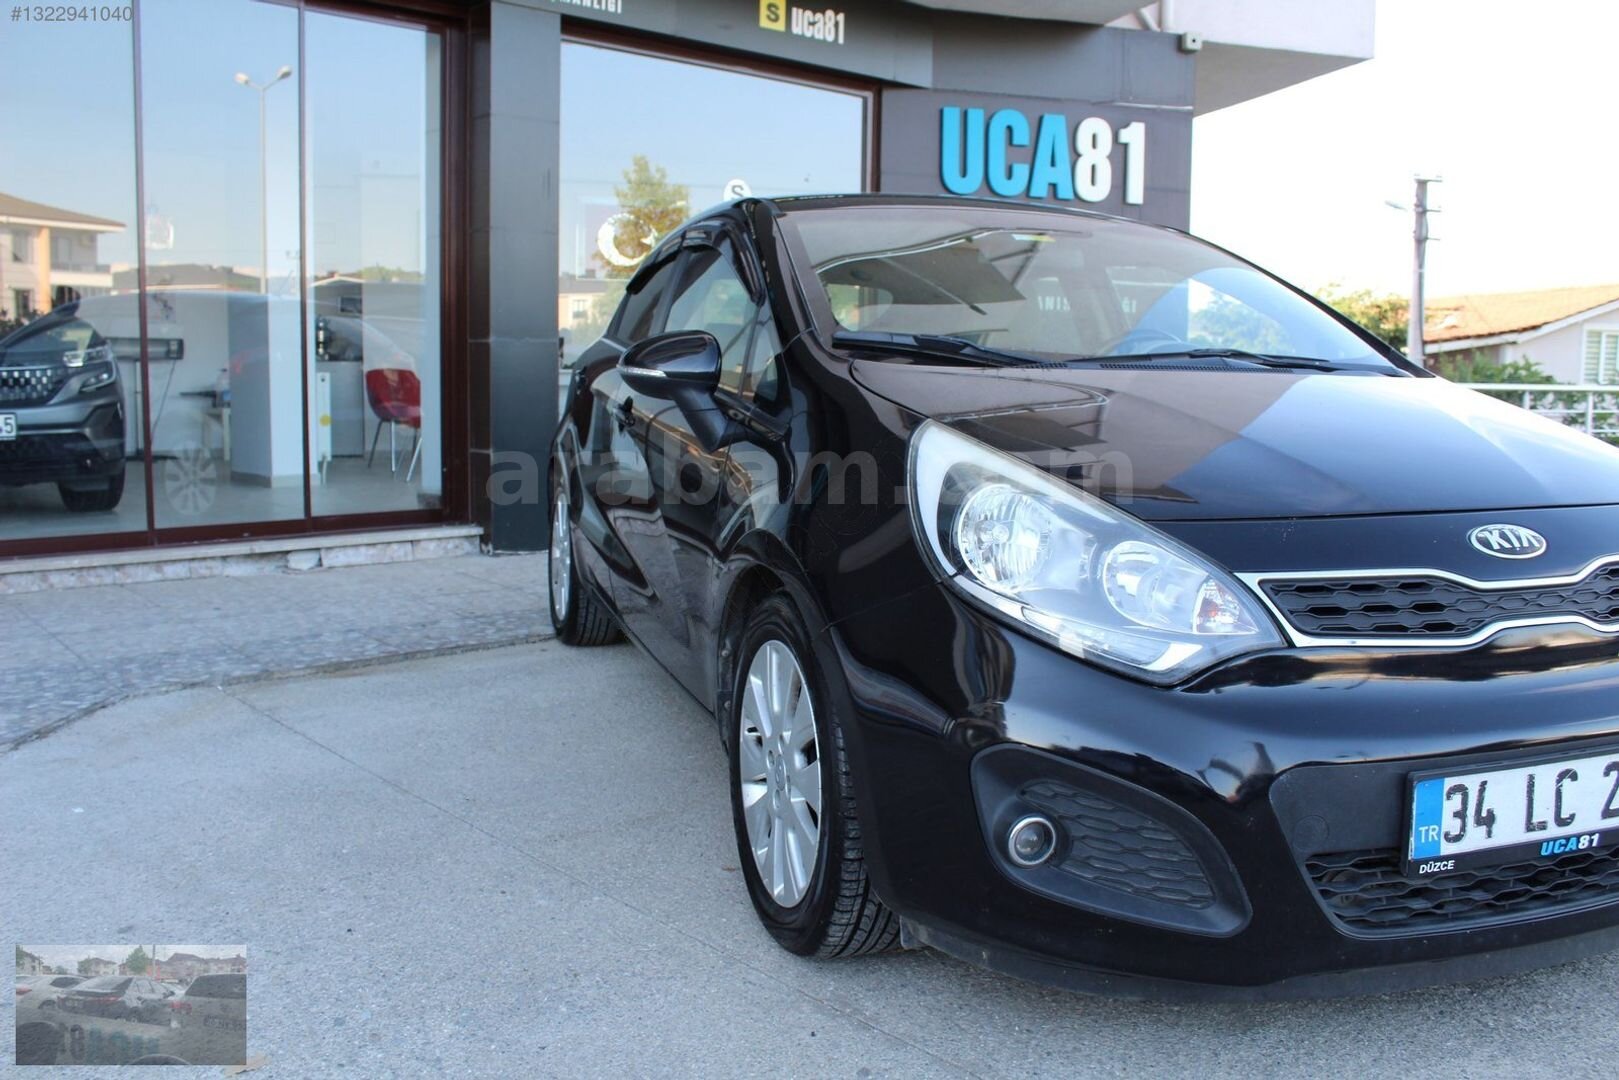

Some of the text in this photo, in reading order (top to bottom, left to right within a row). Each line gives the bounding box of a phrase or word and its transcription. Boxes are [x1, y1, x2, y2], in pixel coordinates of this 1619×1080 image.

[791, 7, 845, 45] uca81
[940, 106, 1146, 205] UCA81
[1477, 529, 1540, 550] KIA
[1443, 780, 1497, 844] 34
[1525, 768, 1579, 834] LC
[1418, 825, 1439, 844] TR
[1540, 833, 1600, 857] UCA81
[1418, 860, 1456, 875] DÜZCE
